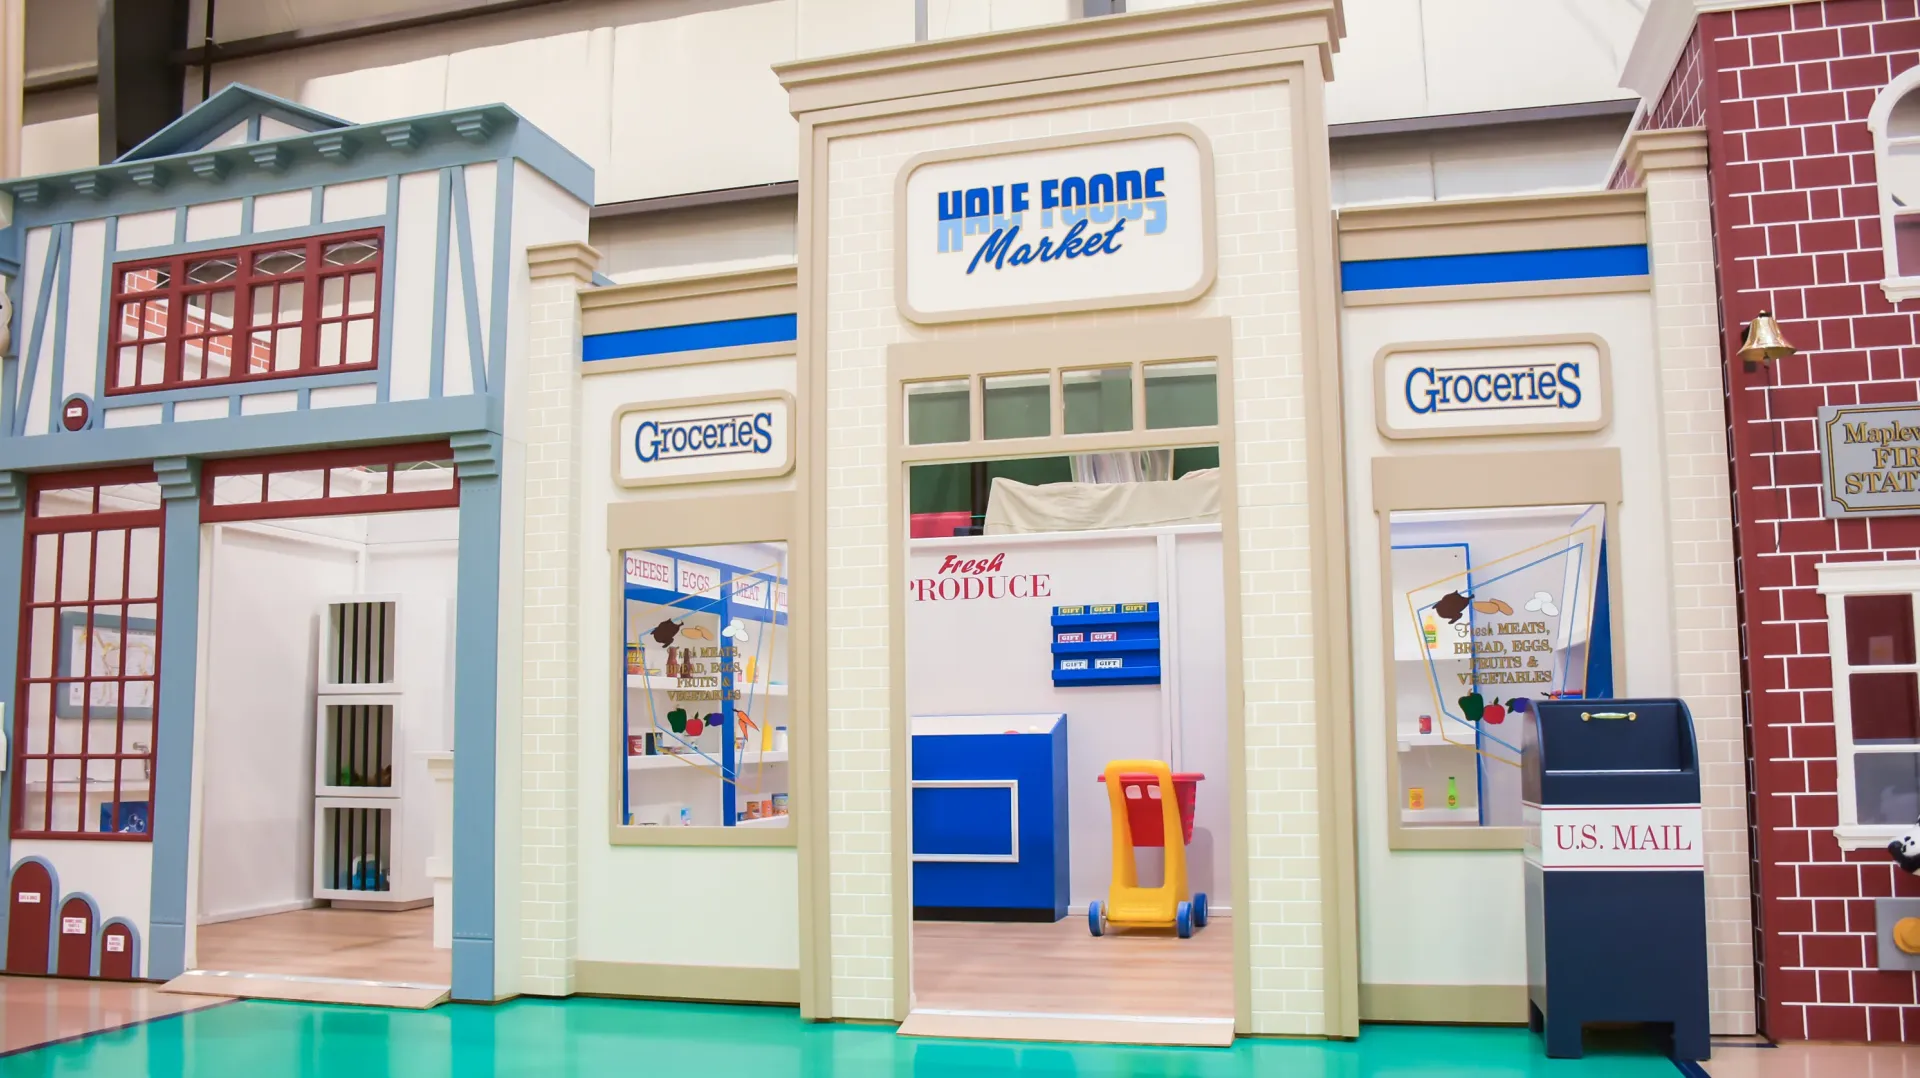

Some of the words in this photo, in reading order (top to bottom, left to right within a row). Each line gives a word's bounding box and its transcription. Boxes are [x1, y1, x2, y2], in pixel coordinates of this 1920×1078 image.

[937, 181, 1029, 253] HALF
[1040, 166, 1168, 236] FOODS
[966, 217, 1127, 275] Market
[1845, 471, 1920, 494] STAT
[626, 557, 669, 583] CHEESE
[938, 552, 1005, 575] Fresh
[682, 570, 710, 592] EGGS
[736, 581, 760, 602] MEAT
[1454, 622, 1493, 638] Fresh
[1497, 622, 1550, 636] MEATS,
[700, 646, 741, 659] MEATS,
[1453, 640, 1507, 656] BREAD,
[1512, 639, 1553, 654] EGGS,
[666, 663, 707, 675] BREAD,
[710, 662, 743, 674] EGGS,
[1469, 656, 1522, 670] FRUITS
[1527, 655, 1539, 668] &
[676, 677, 718, 688] FRUITS
[722, 677, 731, 687] &
[1457, 670, 1553, 685] VEGETABLES
[667, 690, 741, 701] VEGETABLES
[1554, 824, 1604, 850] U.S.
[1612, 824, 1692, 851] MAIL
